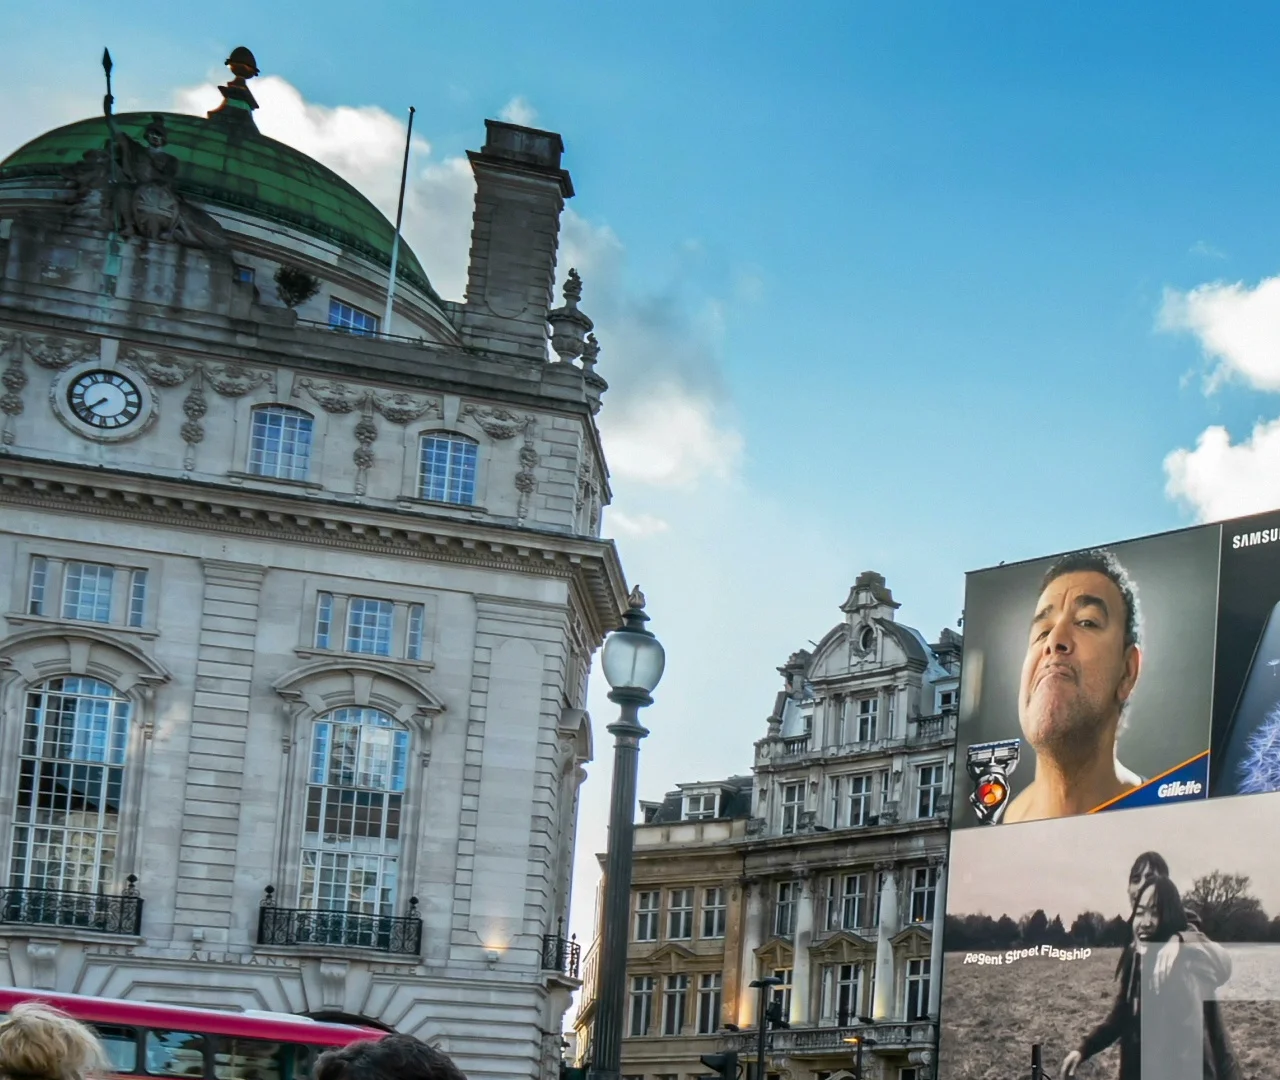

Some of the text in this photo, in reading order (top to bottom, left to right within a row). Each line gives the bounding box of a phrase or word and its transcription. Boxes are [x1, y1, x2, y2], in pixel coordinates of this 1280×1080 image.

[1157, 780, 1202, 798] Gillette
[963, 944, 1092, 965] Regent Street Flagship
